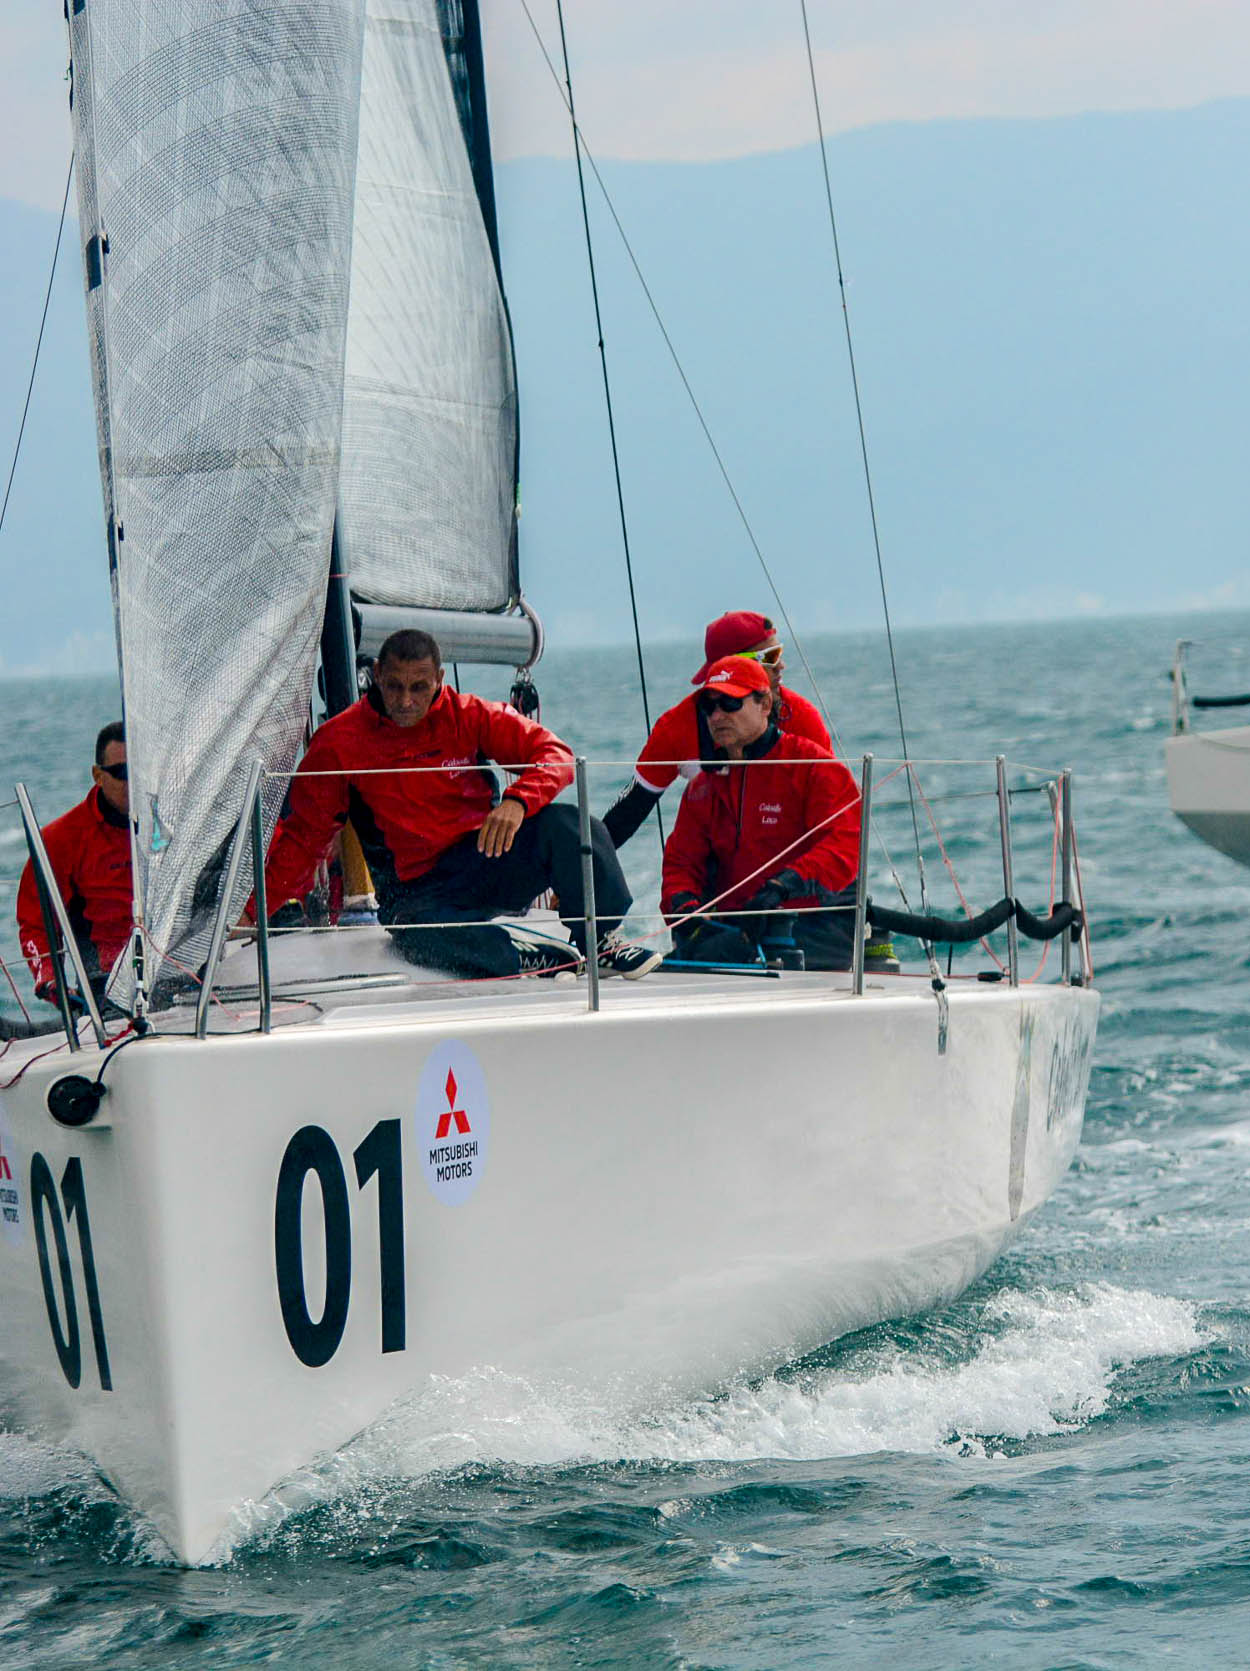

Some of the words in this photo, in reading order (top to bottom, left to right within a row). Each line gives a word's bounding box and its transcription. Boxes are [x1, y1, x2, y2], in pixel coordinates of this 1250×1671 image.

[429, 1140, 478, 1165] MITSUBISHI
[437, 1161, 473, 1182] MOTORS
[30, 1151, 113, 1391] 01
[275, 1118, 406, 1368] 01
